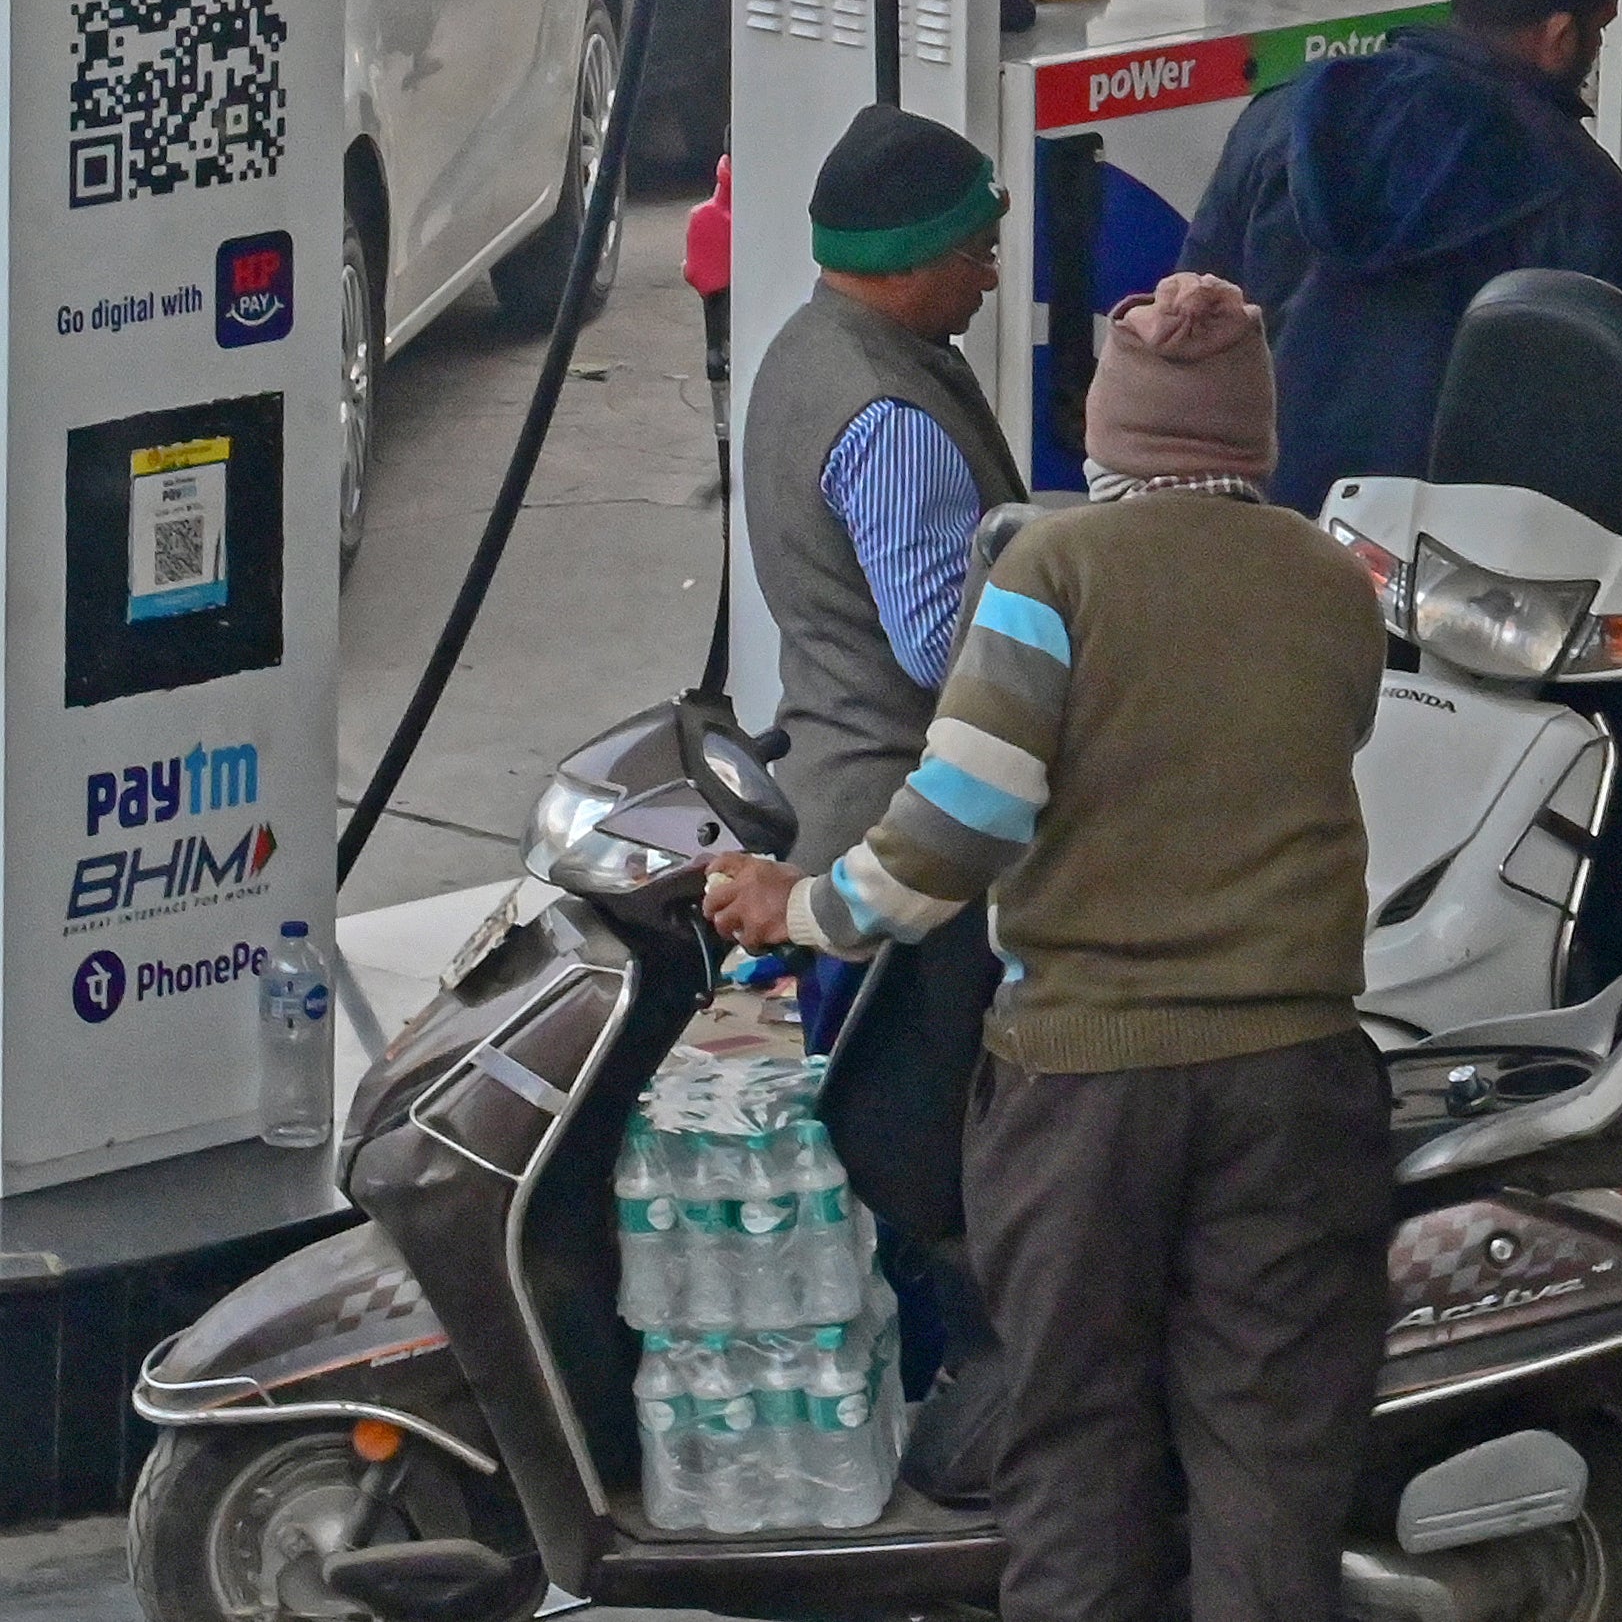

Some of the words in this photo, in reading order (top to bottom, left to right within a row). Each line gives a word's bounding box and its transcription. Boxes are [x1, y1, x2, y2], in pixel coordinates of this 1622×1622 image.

[57, 304, 84, 335] Go
[92, 291, 155, 332] digital
[160, 284, 204, 317] with
[239, 293, 270, 314] PAY
[1382, 688, 1457, 714] HONDA
[66, 824, 254, 920] BHIM
[62, 917, 112, 938] BHARAT
[117, 902, 188, 925] INTERFACE
[193, 893, 220, 910] FOR
[224, 883, 270, 903] MONEY
[137, 940, 270, 1002] PhonePe
